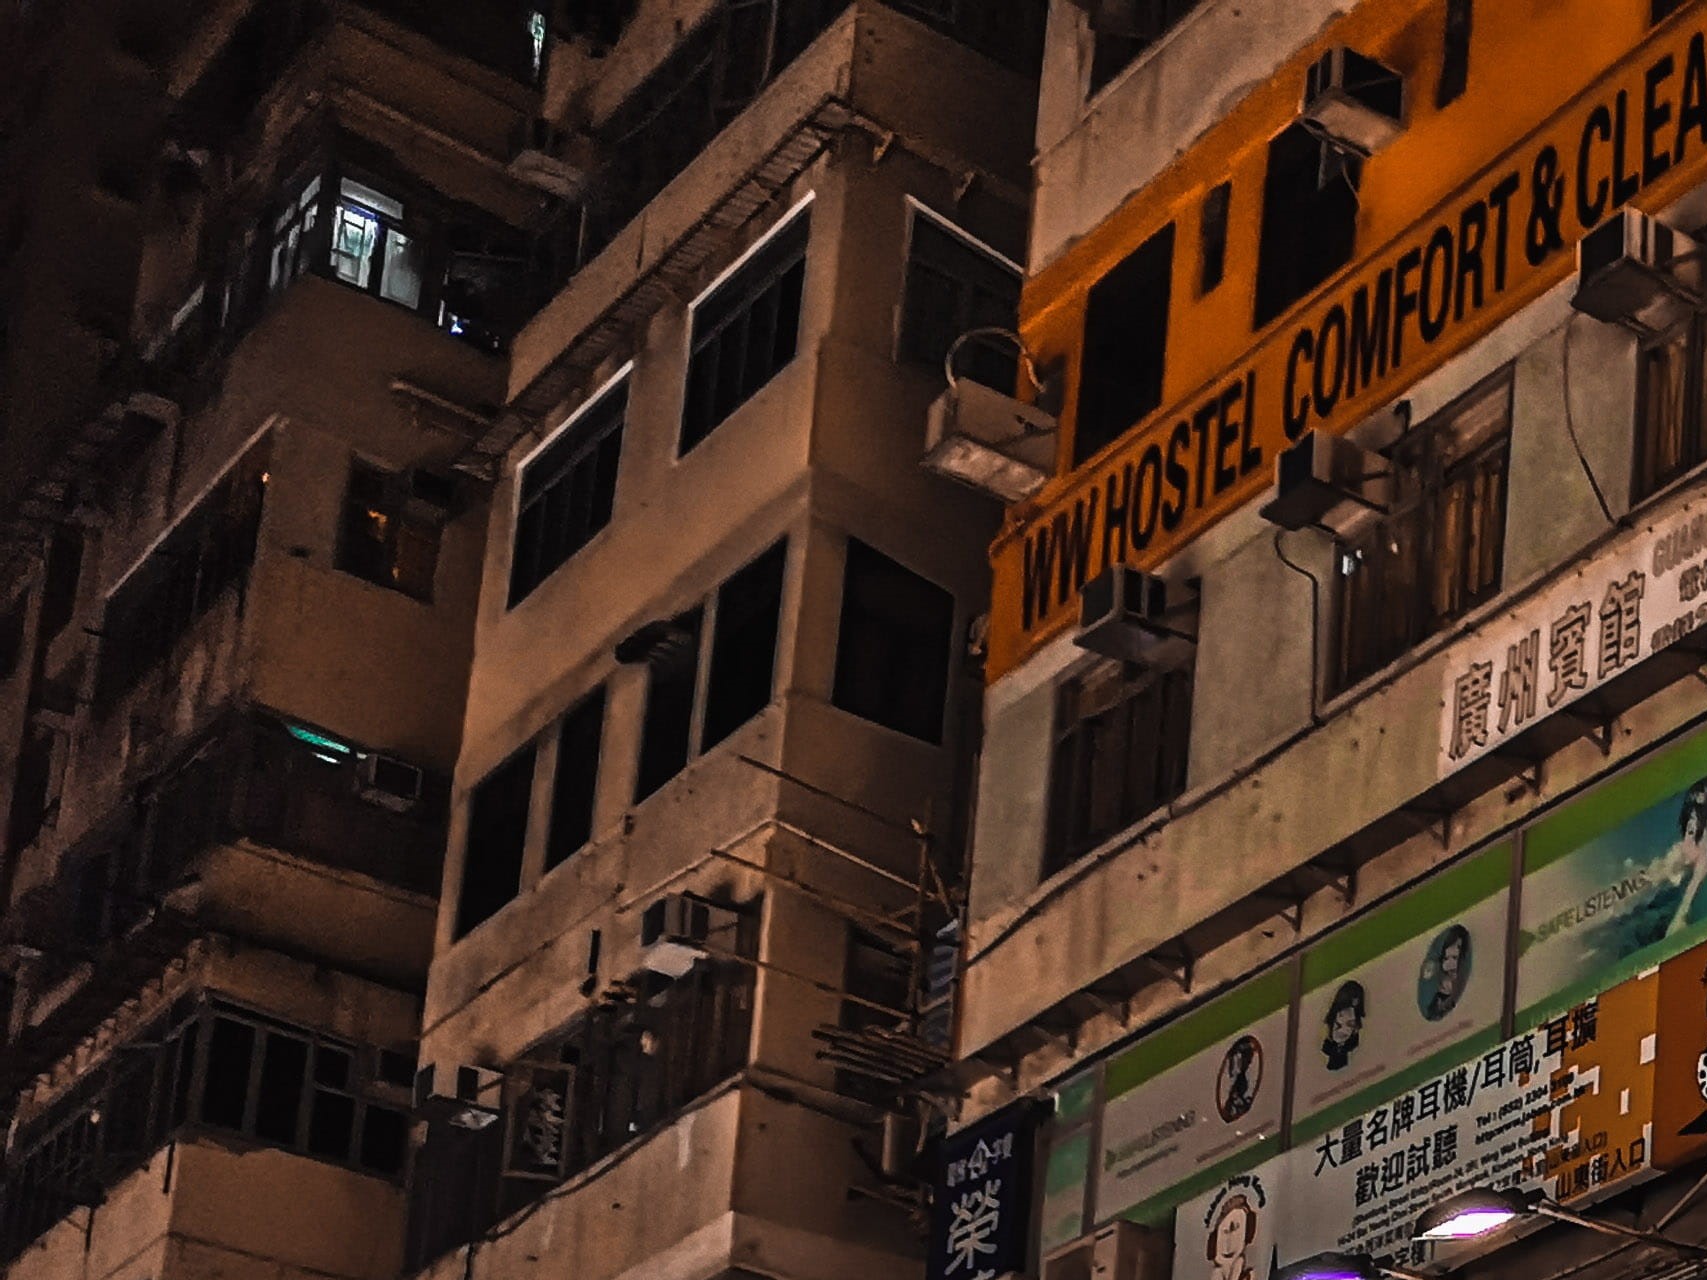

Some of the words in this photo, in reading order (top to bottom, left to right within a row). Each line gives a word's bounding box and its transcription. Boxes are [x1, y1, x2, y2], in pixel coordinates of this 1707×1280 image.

[1104, 397, 1263, 563] HOSTEL
[1284, 161, 1517, 438] COMFORT
[1525, 146, 1566, 266] &
[1449, 571, 1645, 759] 廣州賓館
[1356, 1125, 1458, 1207] 歡迎試聽
